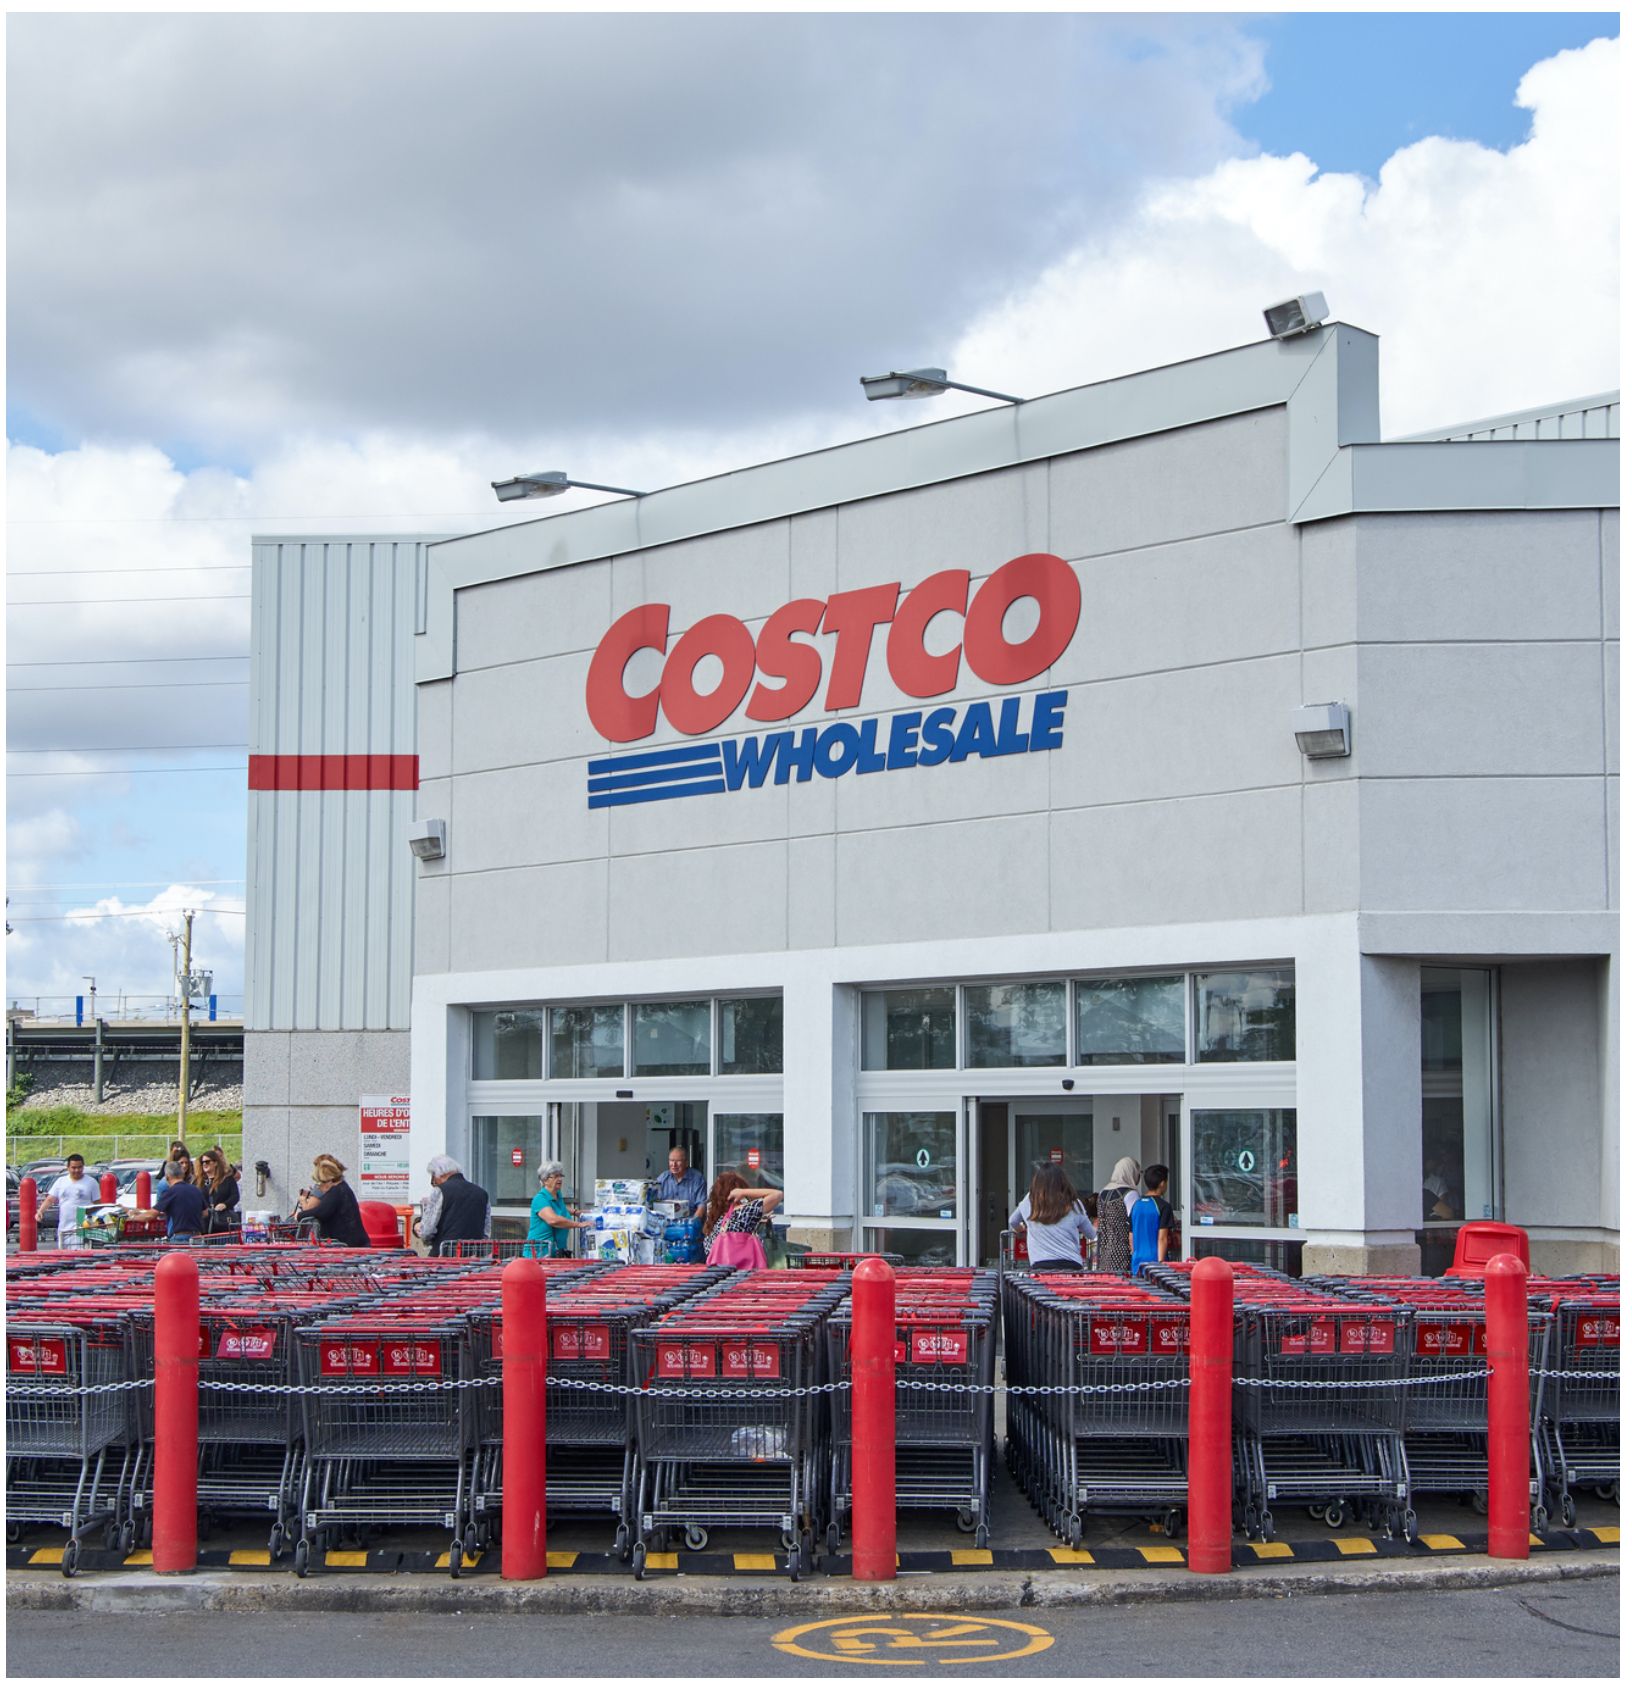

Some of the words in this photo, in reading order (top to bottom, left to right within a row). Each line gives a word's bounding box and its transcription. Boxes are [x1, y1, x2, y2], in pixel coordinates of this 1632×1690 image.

[585, 552, 1082, 743] COSTCO
[722, 690, 1068, 792] WHOLESALE
[363, 1109, 394, 1117] HEURES
[377, 1119, 388, 1127] DE
